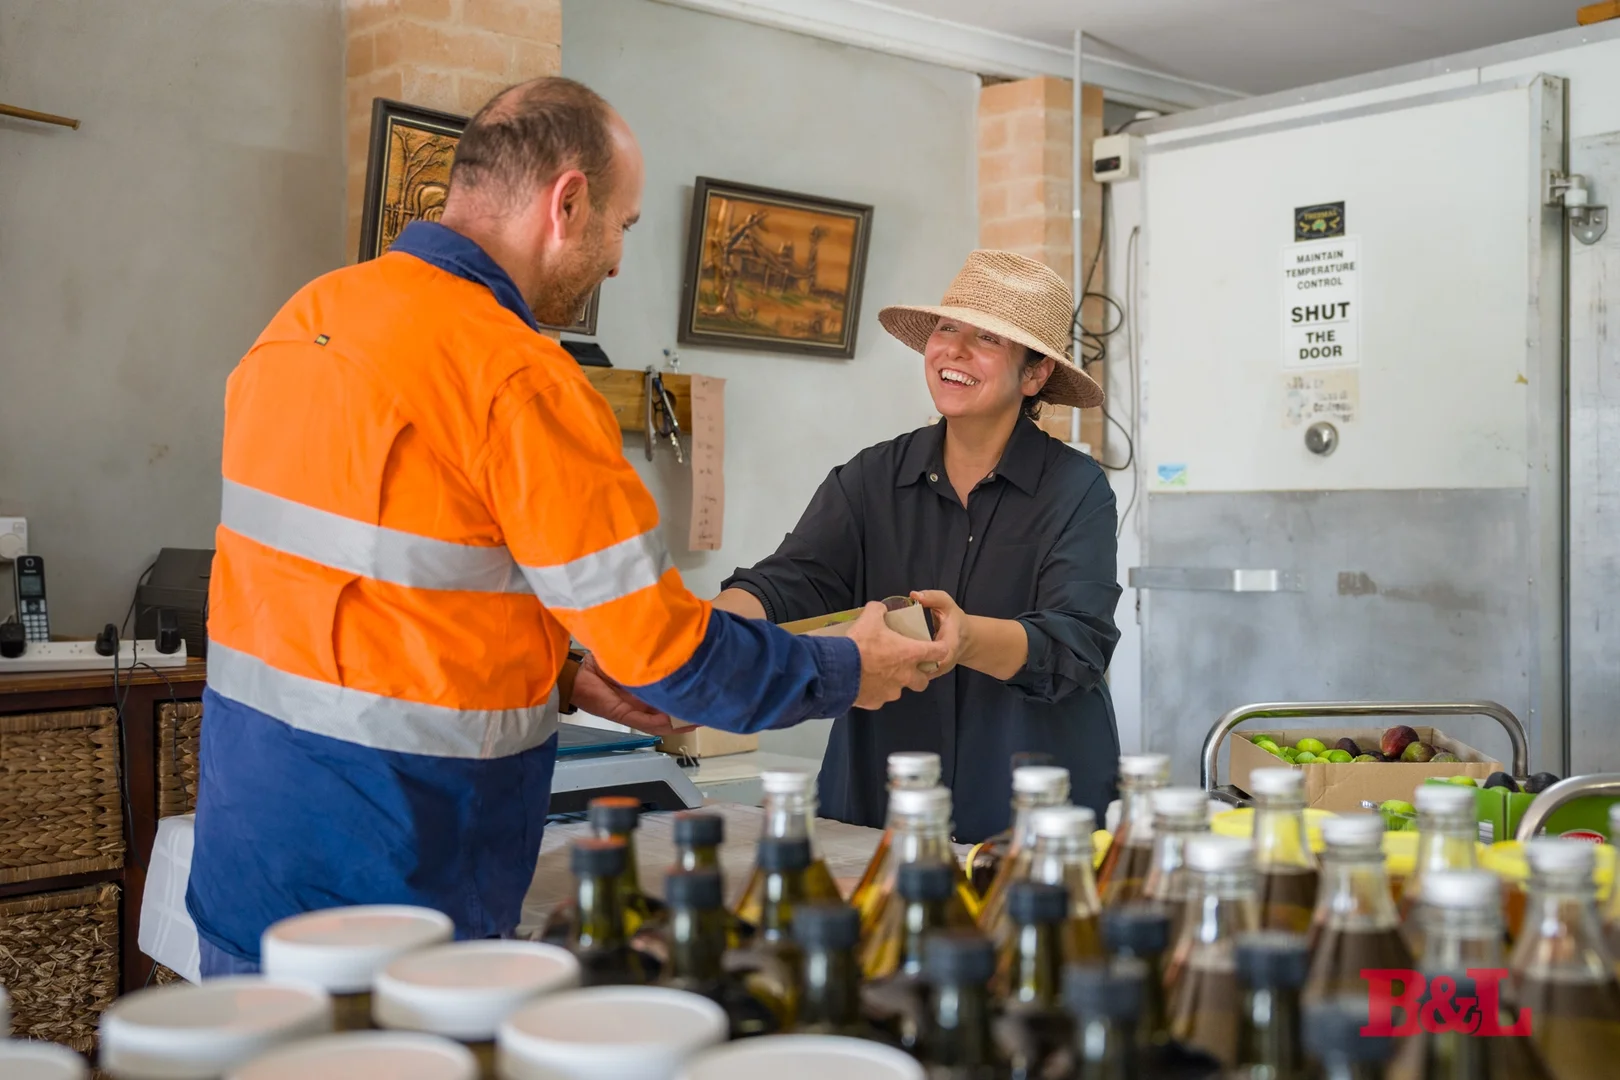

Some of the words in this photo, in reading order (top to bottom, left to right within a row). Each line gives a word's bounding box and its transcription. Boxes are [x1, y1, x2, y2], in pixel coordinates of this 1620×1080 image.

[1296, 250, 1344, 263] MAINTAIN
[1286, 261, 1356, 278] TEMPERATURE
[1297, 276, 1343, 291] CONTROL
[1291, 301, 1351, 323] SHUT
[1305, 329, 1336, 344] THE
[1299, 345, 1343, 360] DOOR
